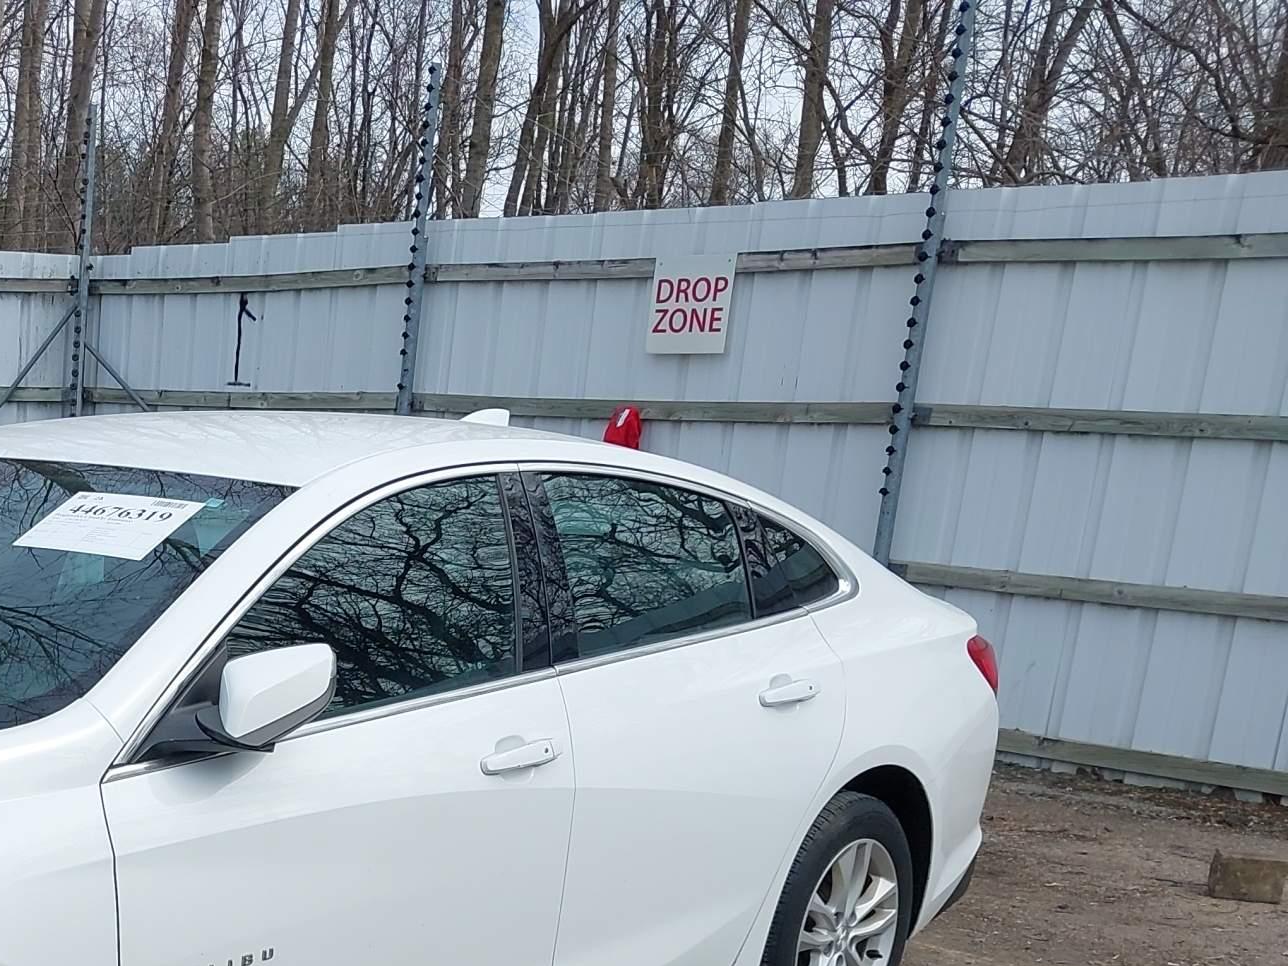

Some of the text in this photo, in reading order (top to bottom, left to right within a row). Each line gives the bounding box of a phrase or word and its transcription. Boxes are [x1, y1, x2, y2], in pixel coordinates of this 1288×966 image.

[655, 276, 729, 304] DROP
[652, 307, 724, 333] ZONE
[69, 503, 173, 523] 44676319
